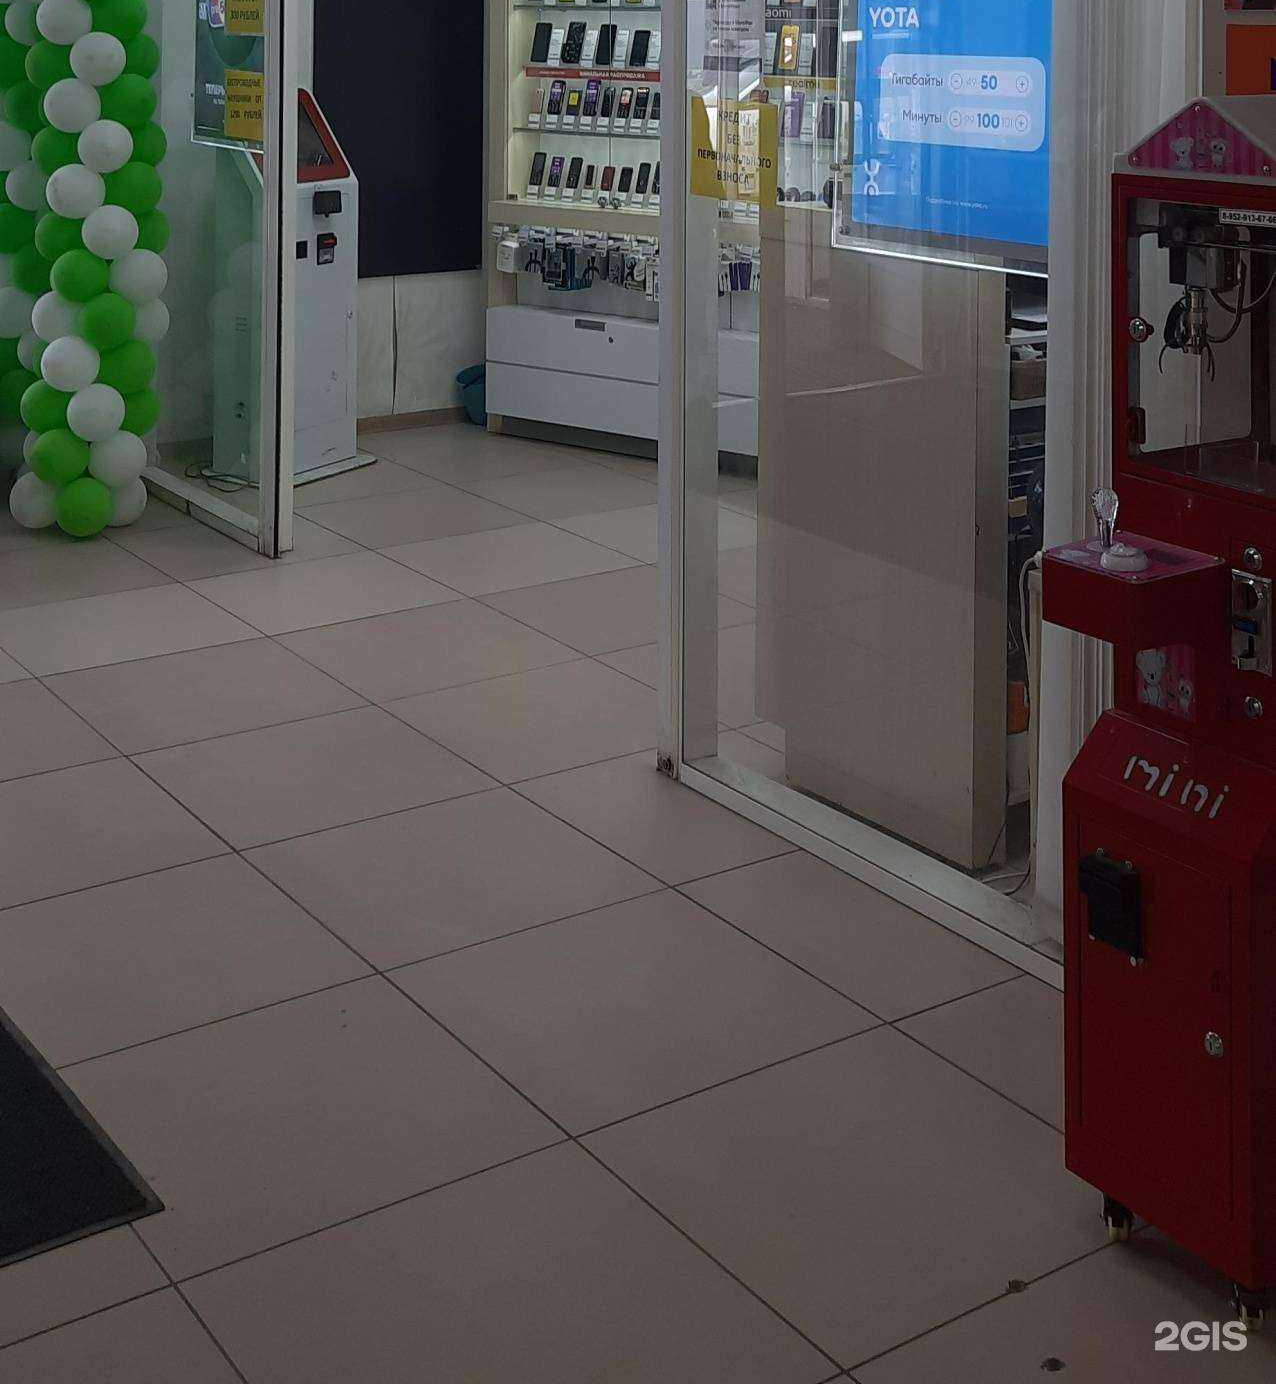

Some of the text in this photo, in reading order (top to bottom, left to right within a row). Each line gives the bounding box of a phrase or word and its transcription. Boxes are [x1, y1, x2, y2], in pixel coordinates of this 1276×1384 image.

[869, 7, 920, 28] YOTA
[981, 75, 998, 90] 50
[902, 110, 942, 125] Минуты
[977, 113, 1000, 129] 100
[1124, 756, 1229, 818] mini
